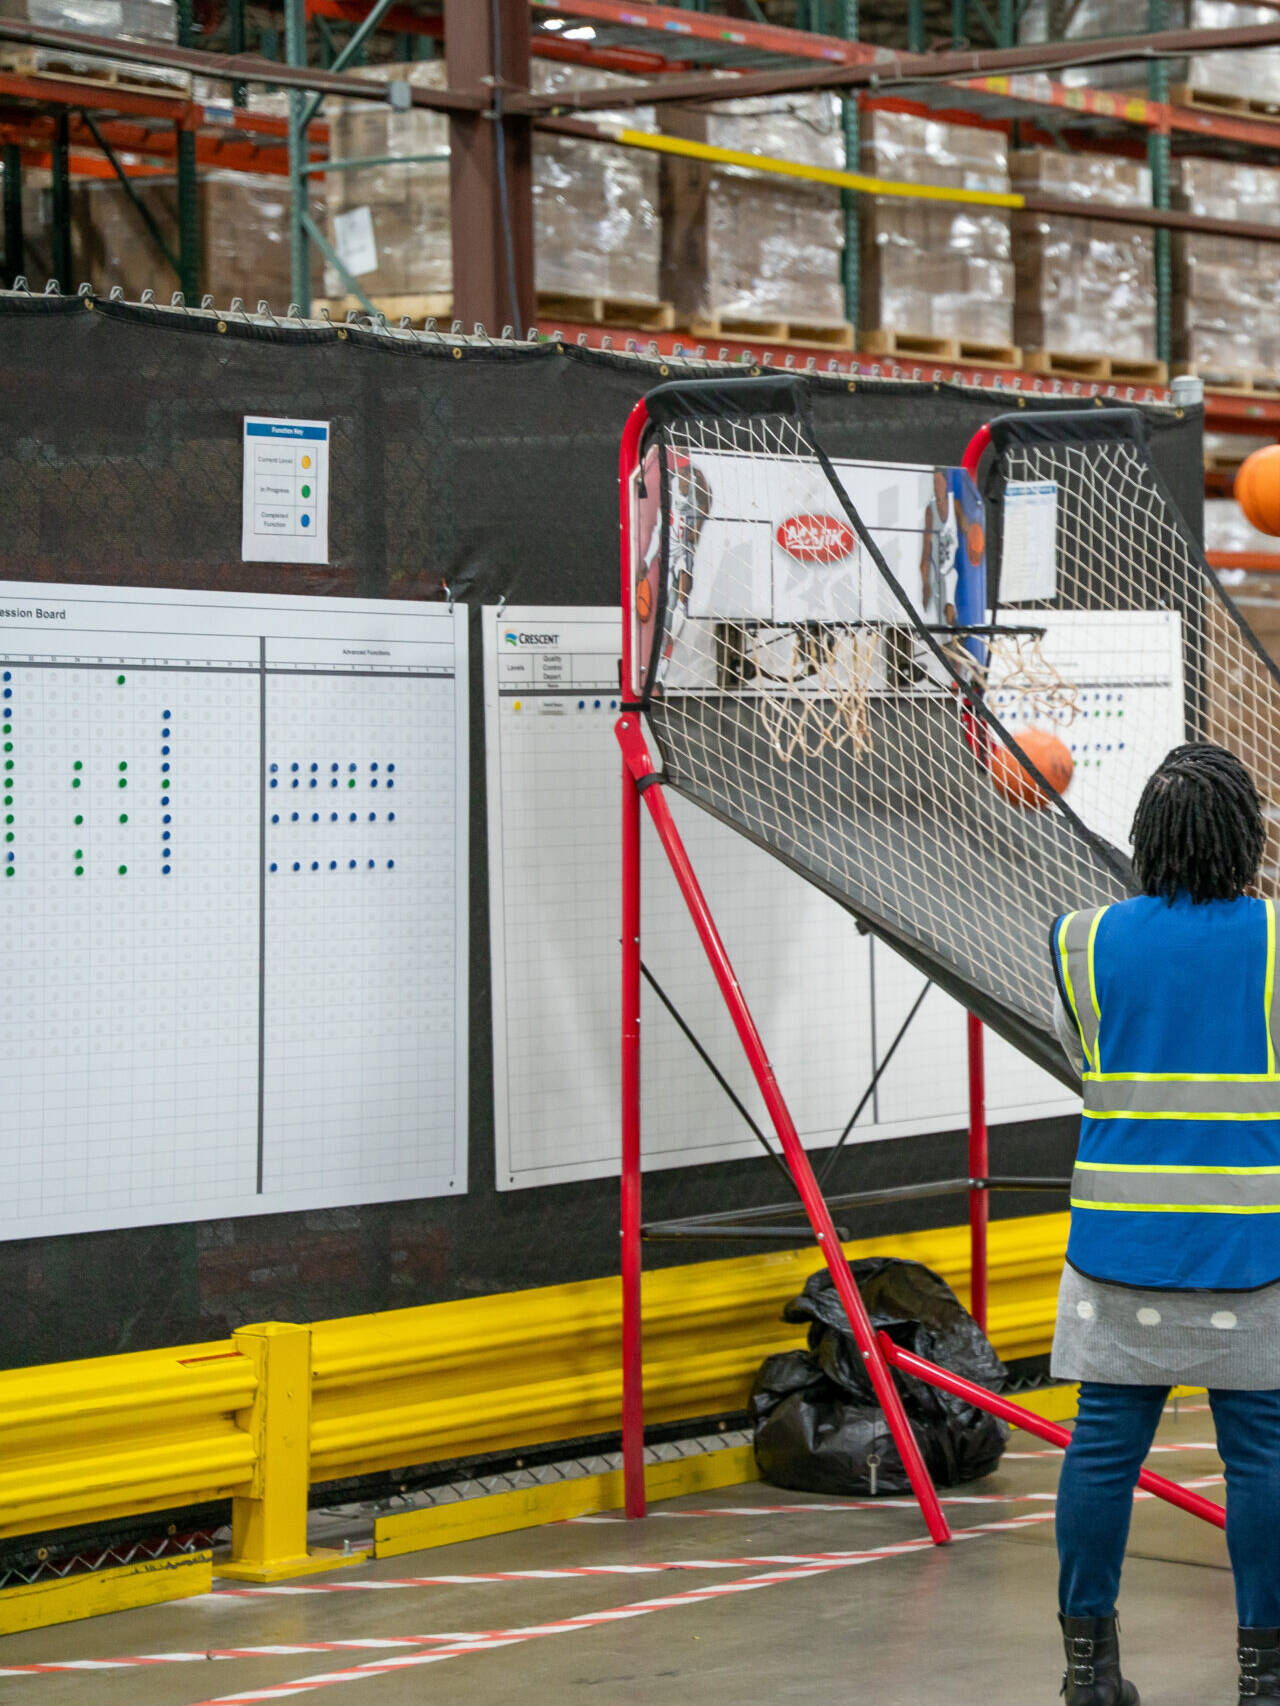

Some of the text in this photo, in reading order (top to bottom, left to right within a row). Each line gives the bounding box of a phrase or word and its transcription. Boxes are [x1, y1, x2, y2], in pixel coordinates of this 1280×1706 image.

[271, 426, 294, 435] Function
[260, 511, 289, 519] Completed
[0, 607, 66, 620] ession Board
[518, 632, 560, 645] CRESCENT
[543, 655, 562, 663] Quality
